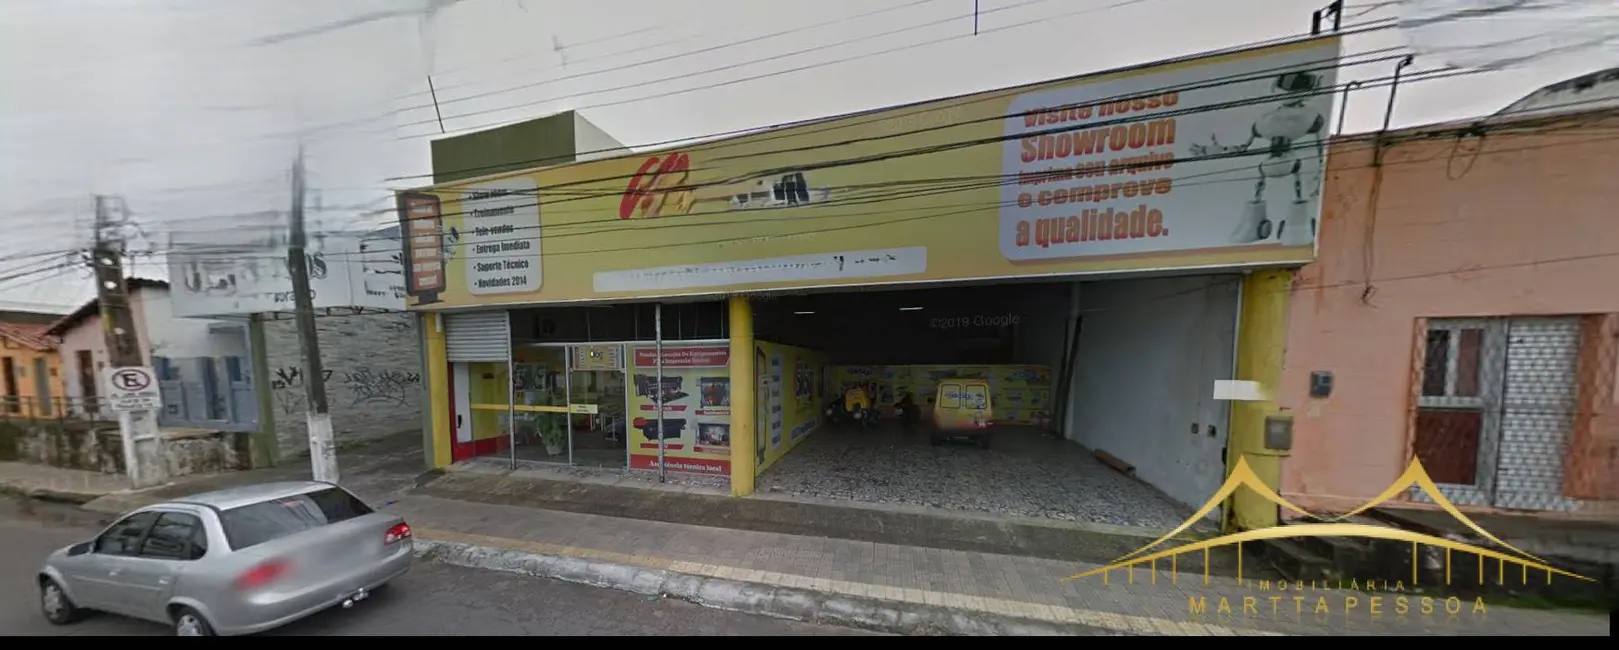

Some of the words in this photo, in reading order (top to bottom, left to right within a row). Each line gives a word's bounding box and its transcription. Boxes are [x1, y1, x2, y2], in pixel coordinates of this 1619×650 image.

[1020, 118, 1177, 164] Showroom
[1015, 221, 1030, 248] a
[1035, 203, 1169, 249] qualidade.
[476, 243, 501, 255] Entrega
[477, 261, 502, 273] Suporte
[502, 257, 529, 271] Técnico
[478, 276, 511, 288] Novidades
[511, 275, 527, 286] 2014
